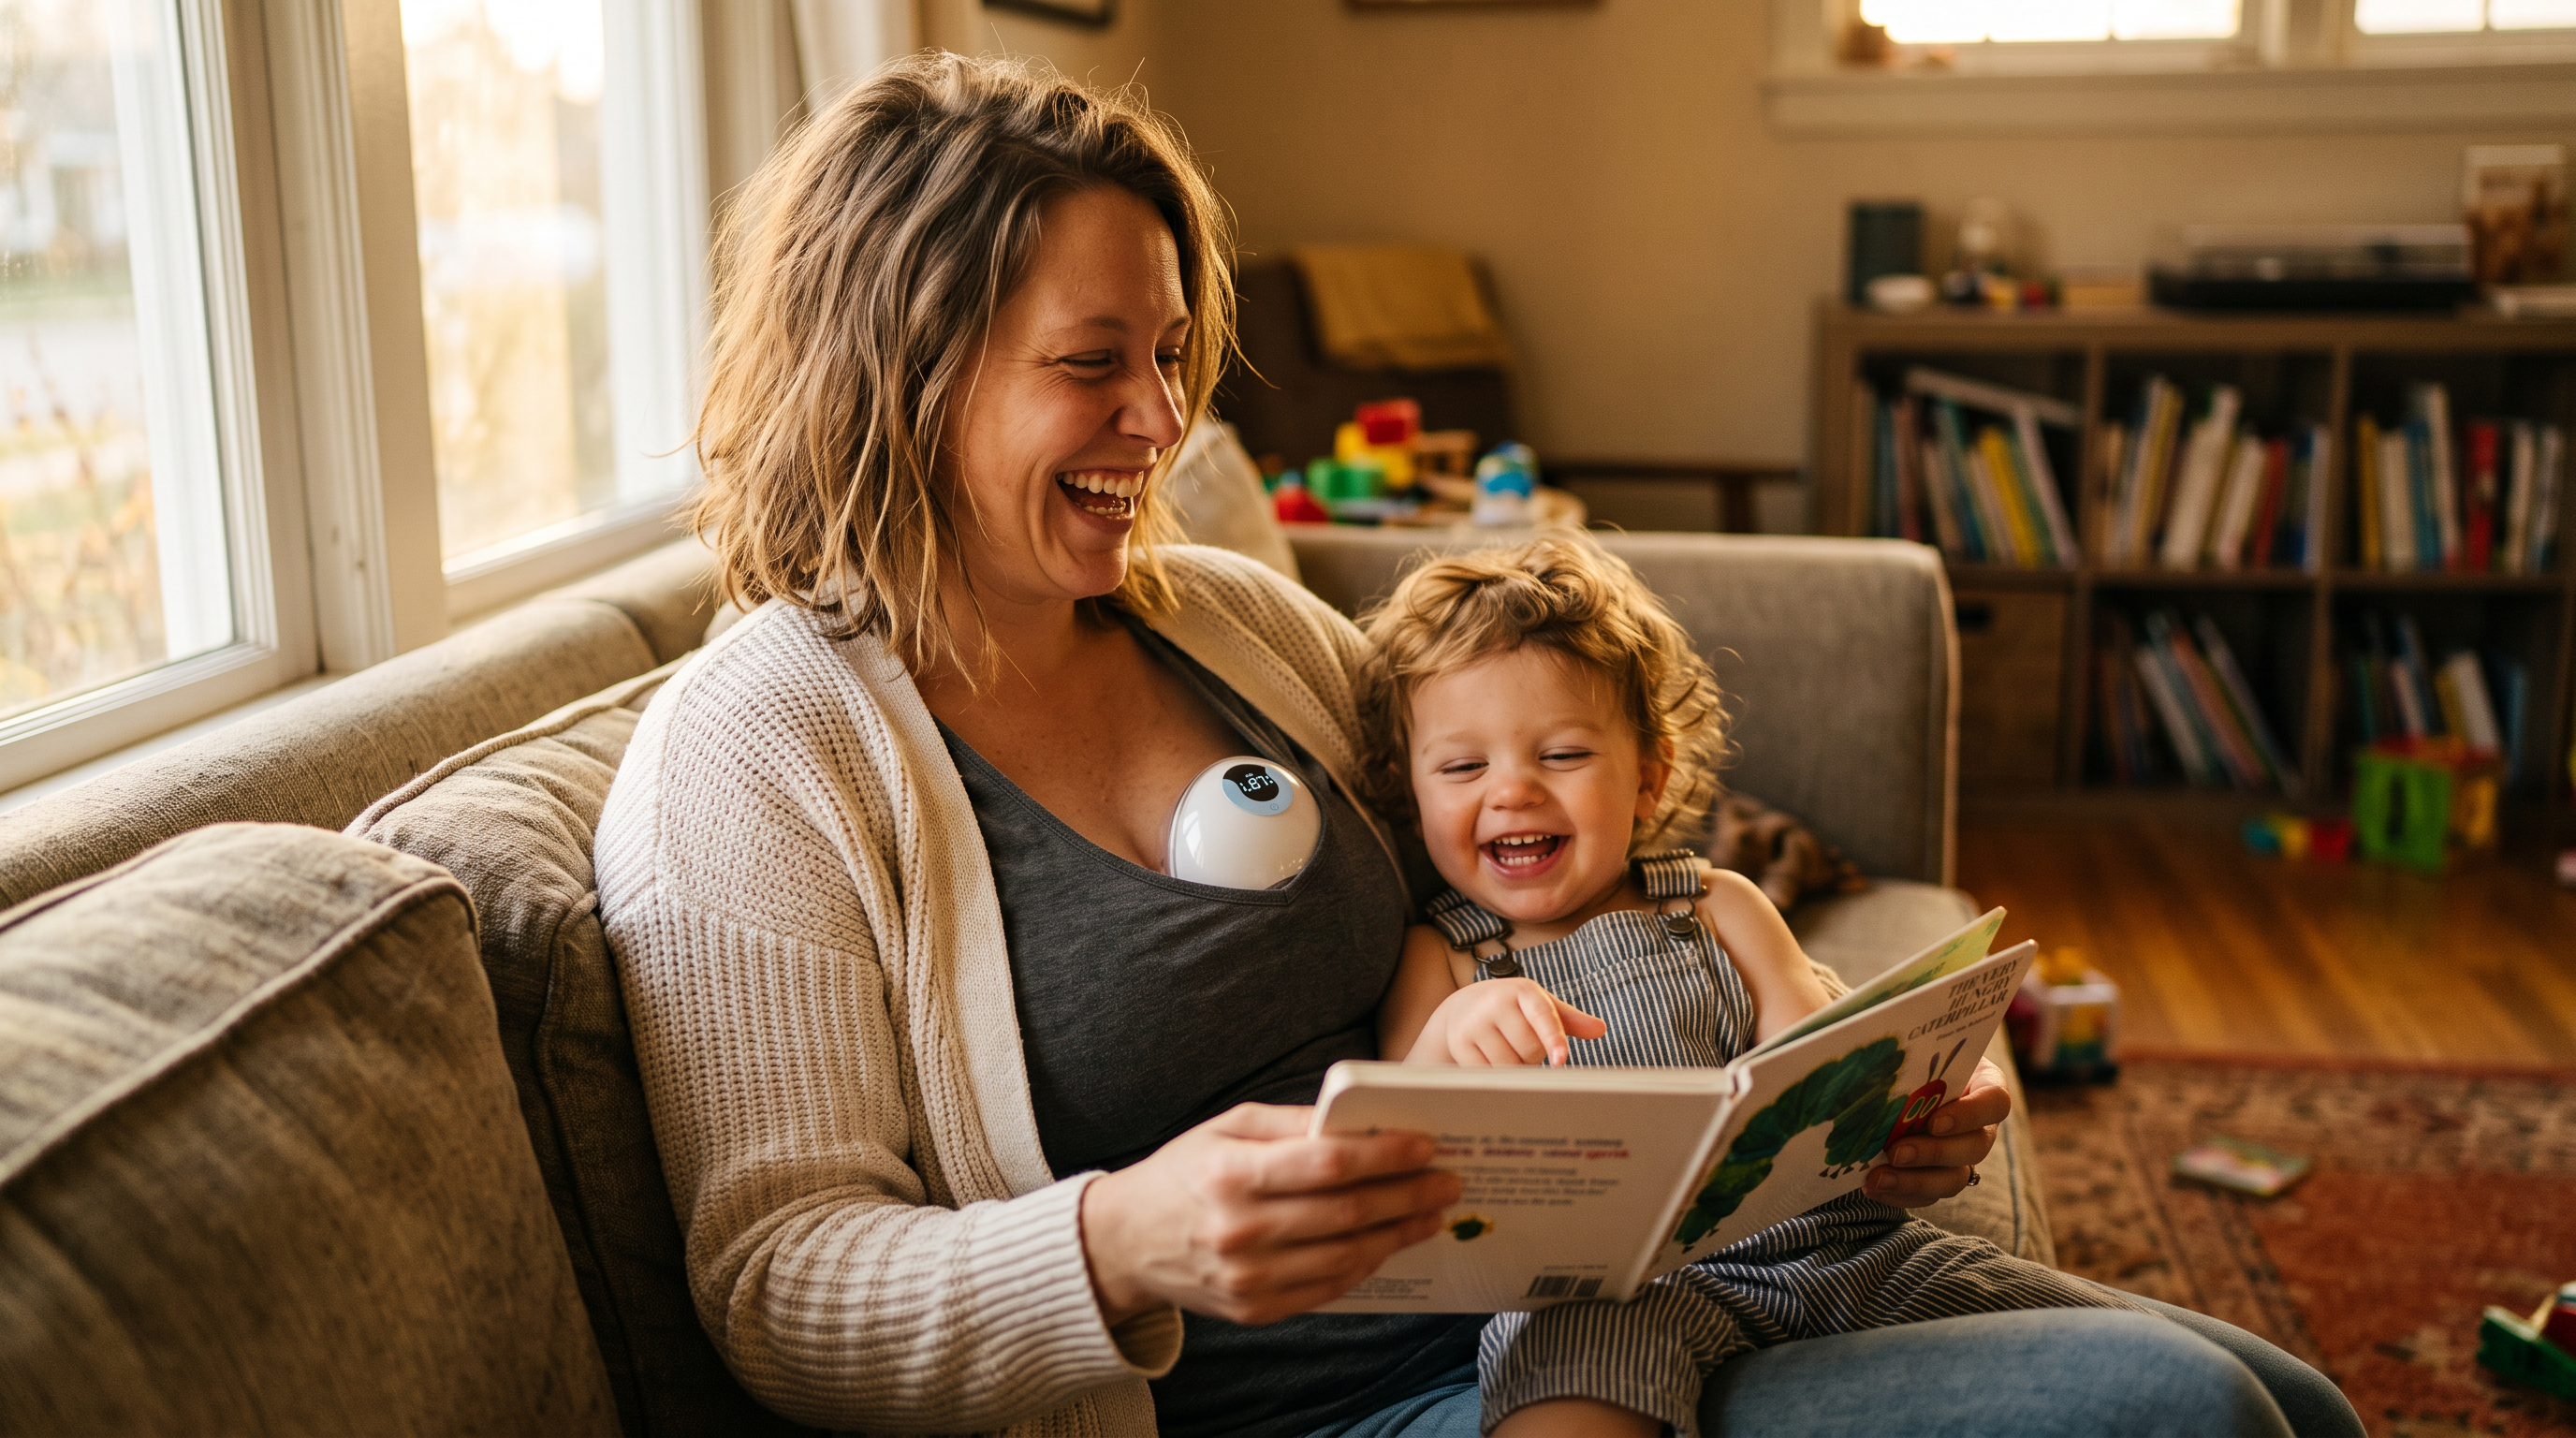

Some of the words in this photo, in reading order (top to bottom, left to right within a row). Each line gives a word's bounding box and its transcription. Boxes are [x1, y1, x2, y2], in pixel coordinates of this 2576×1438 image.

[1948, 975, 1981, 999] THE
[1982, 956, 2024, 984] VERY
[1948, 972, 2016, 1012] HUNGRY
[1908, 989, 2009, 1040] CATERPILLAR
